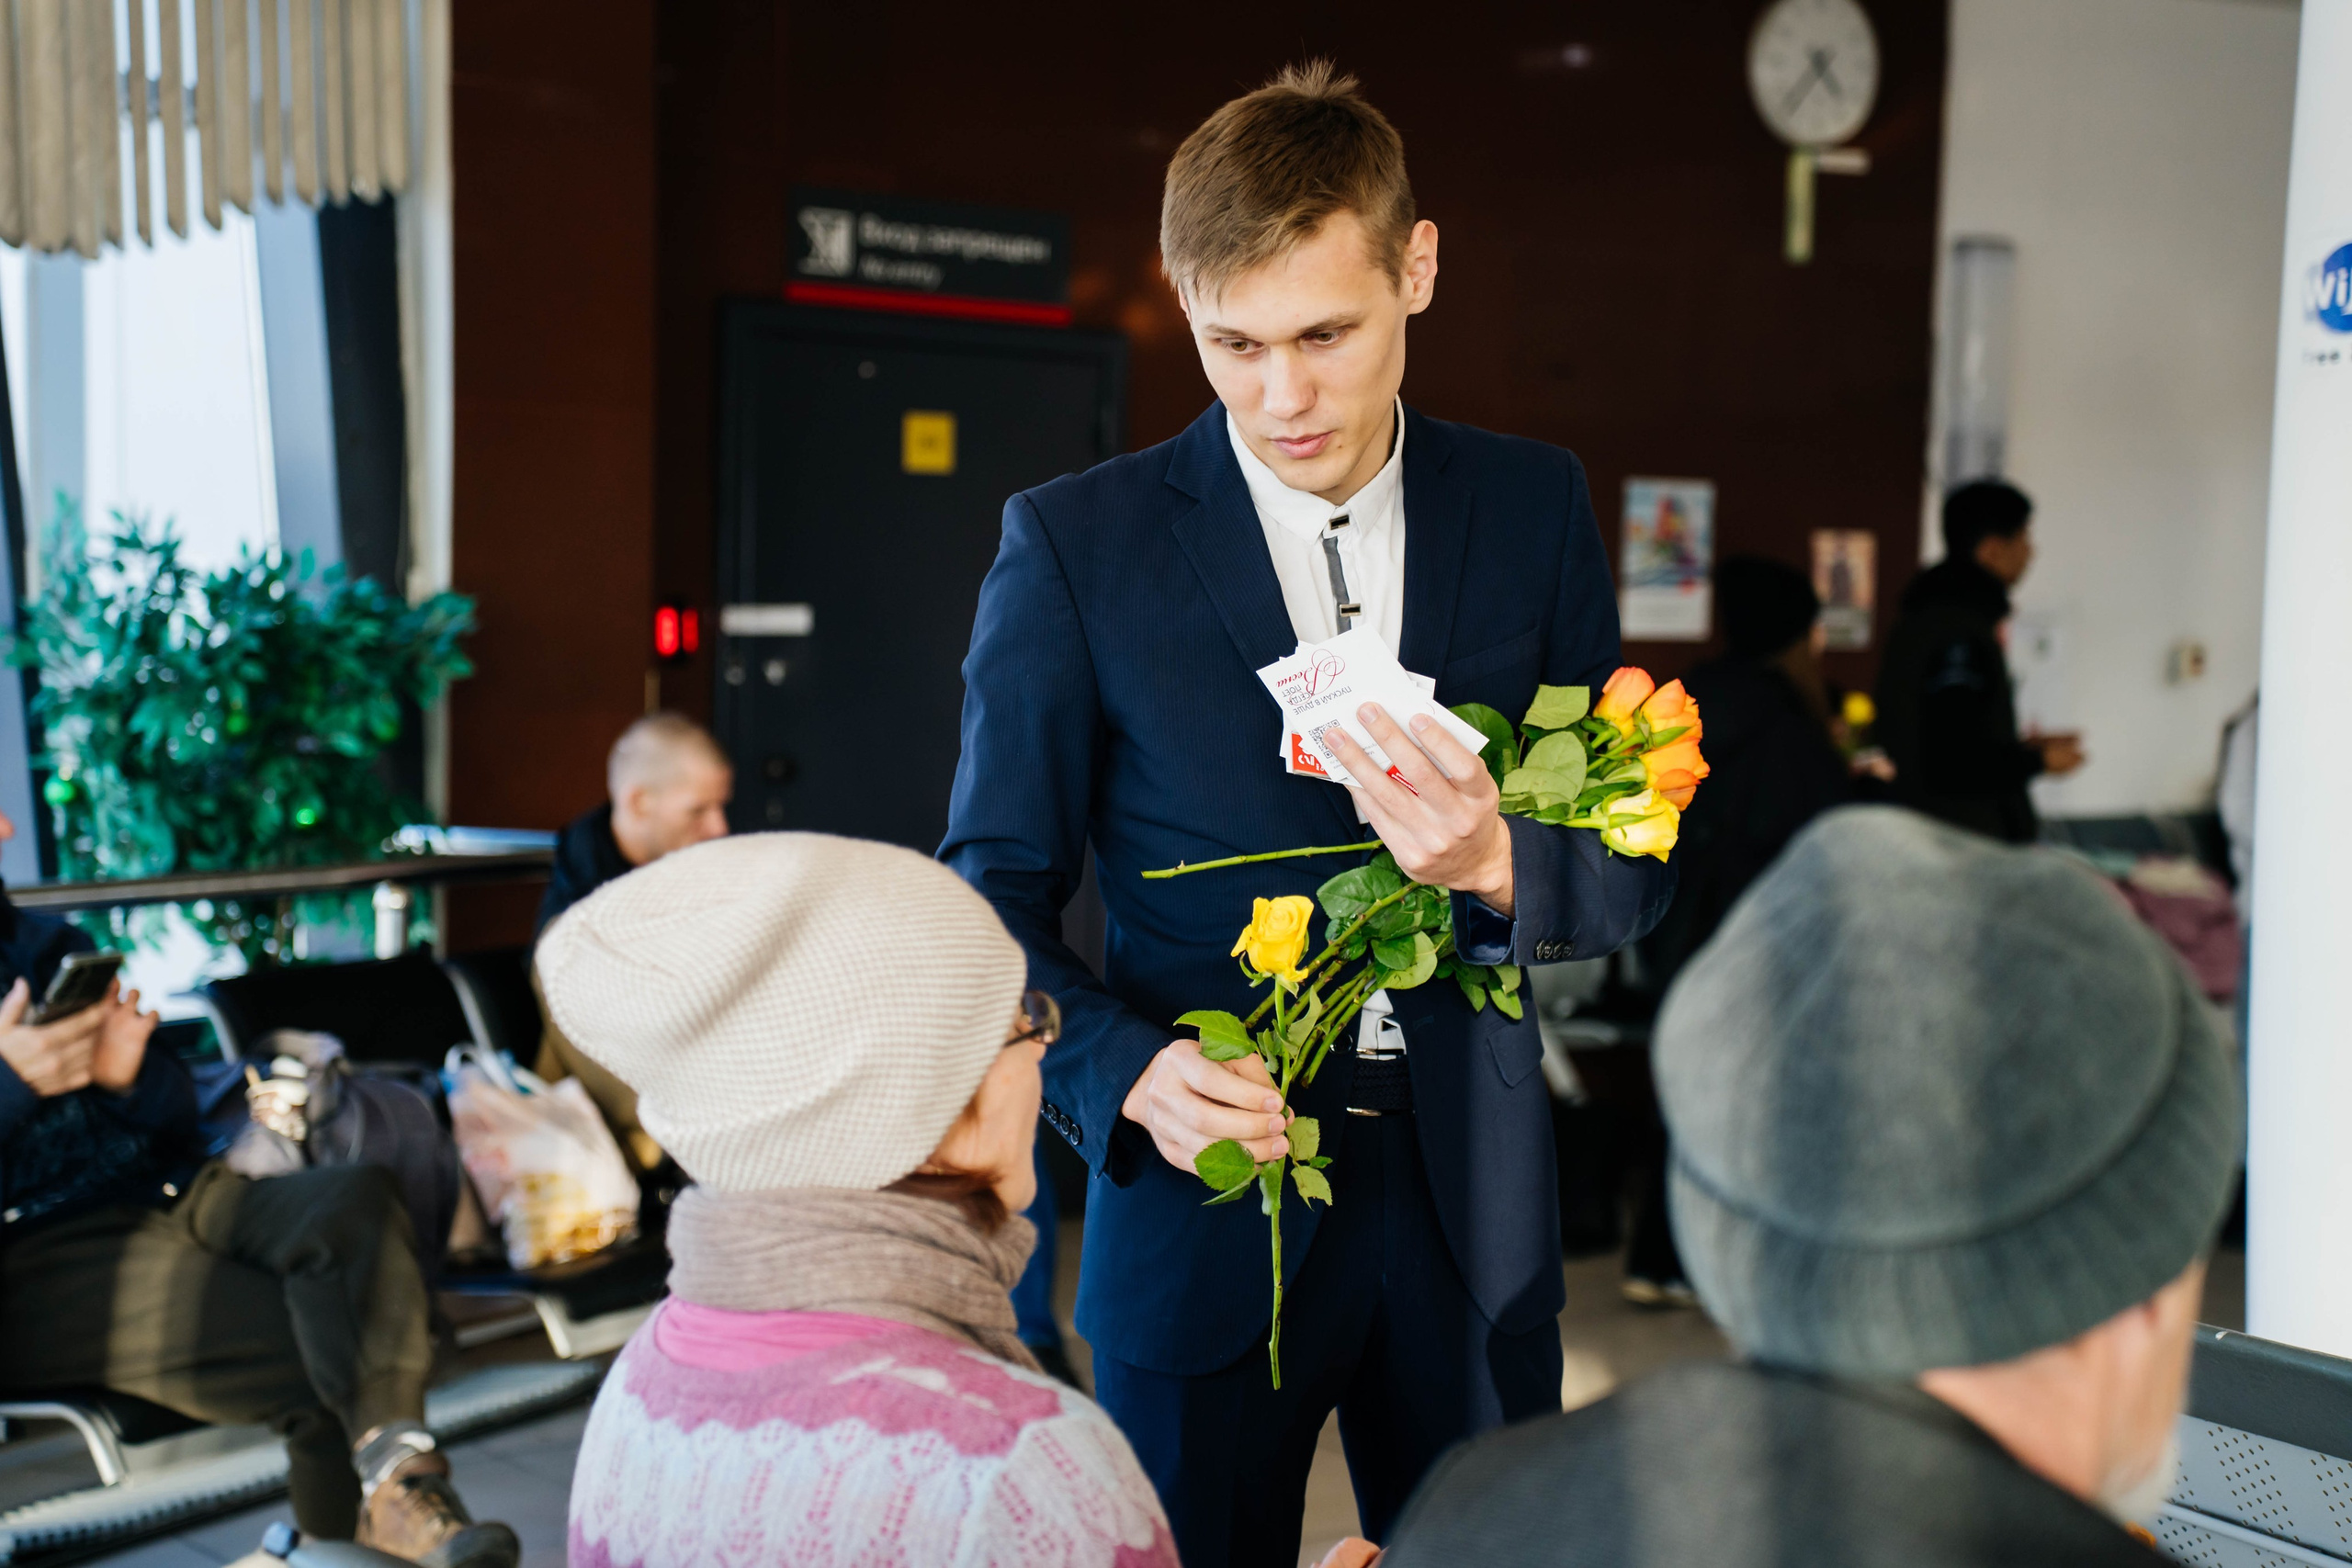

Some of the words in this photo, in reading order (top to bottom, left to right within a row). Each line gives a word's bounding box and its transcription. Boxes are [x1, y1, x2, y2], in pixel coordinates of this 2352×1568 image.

[1282, 683, 1302, 698] ПОЕТ
[1286, 689, 1315, 706] ВСЕГДА
[1320, 685, 1352, 705] ПУСКАЙ
[1293, 700, 1315, 716] ДУШЕ
[1314, 698, 1321, 706] В
